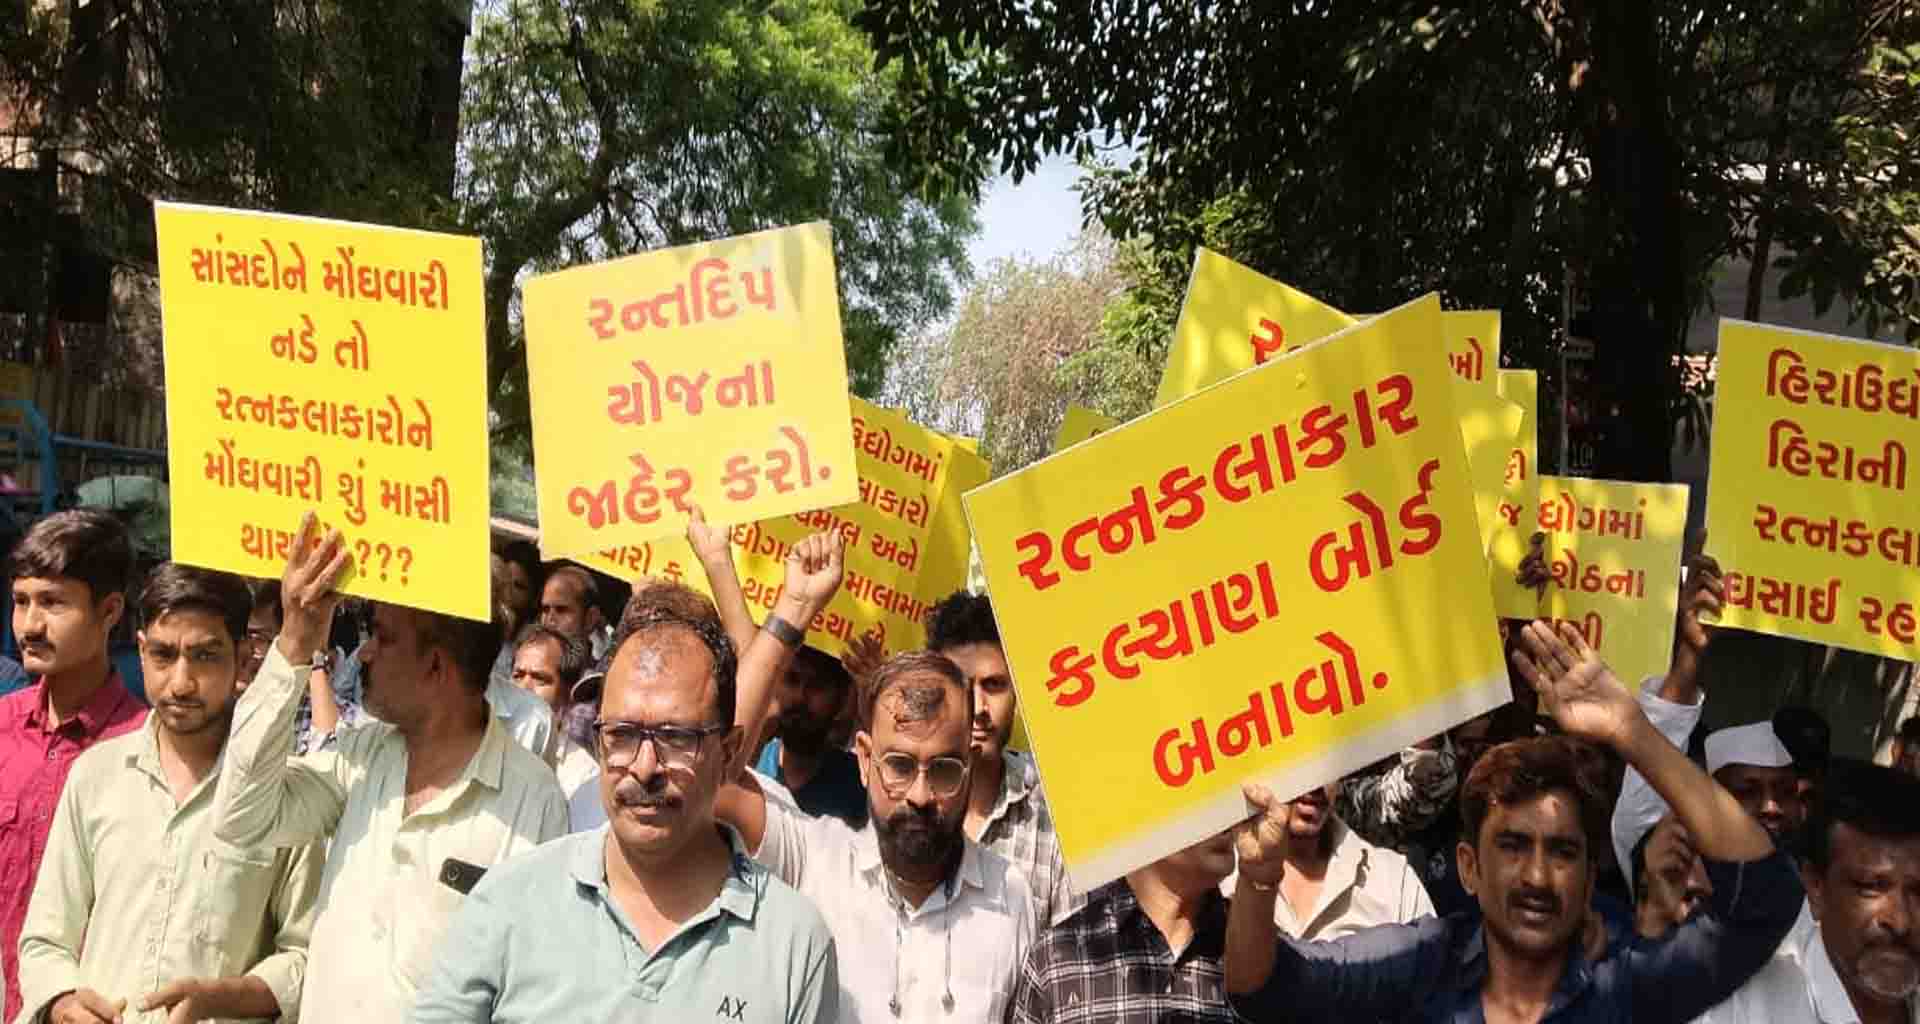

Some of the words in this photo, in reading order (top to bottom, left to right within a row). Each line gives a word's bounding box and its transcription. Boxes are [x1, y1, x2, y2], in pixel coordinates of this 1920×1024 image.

[191, 233, 307, 293] સાંસદોને
[322, 246, 449, 310] મોંઘવારી
[270, 314, 318, 364] નડે
[333, 320, 369, 371] તો
[215, 386, 433, 451] રત્નકલાકારોને
[607, 359, 775, 425] યોજના
[204, 440, 322, 502] મોંઘવારી
[337, 458, 367, 527] શું
[380, 477, 450, 524] માસી
[567, 453, 693, 530] જાહેર
[720, 426, 832, 501] કરો.
[1015, 373, 1419, 592] રત્નકલાકાર
[1767, 419, 1906, 490] હિરાની
[1045, 561, 1280, 708] કલ્યાણ
[1308, 459, 1443, 593] બોર્ડ
[1152, 631, 1390, 787] બનાવો.
[715, 995, 748, 1021] AX
